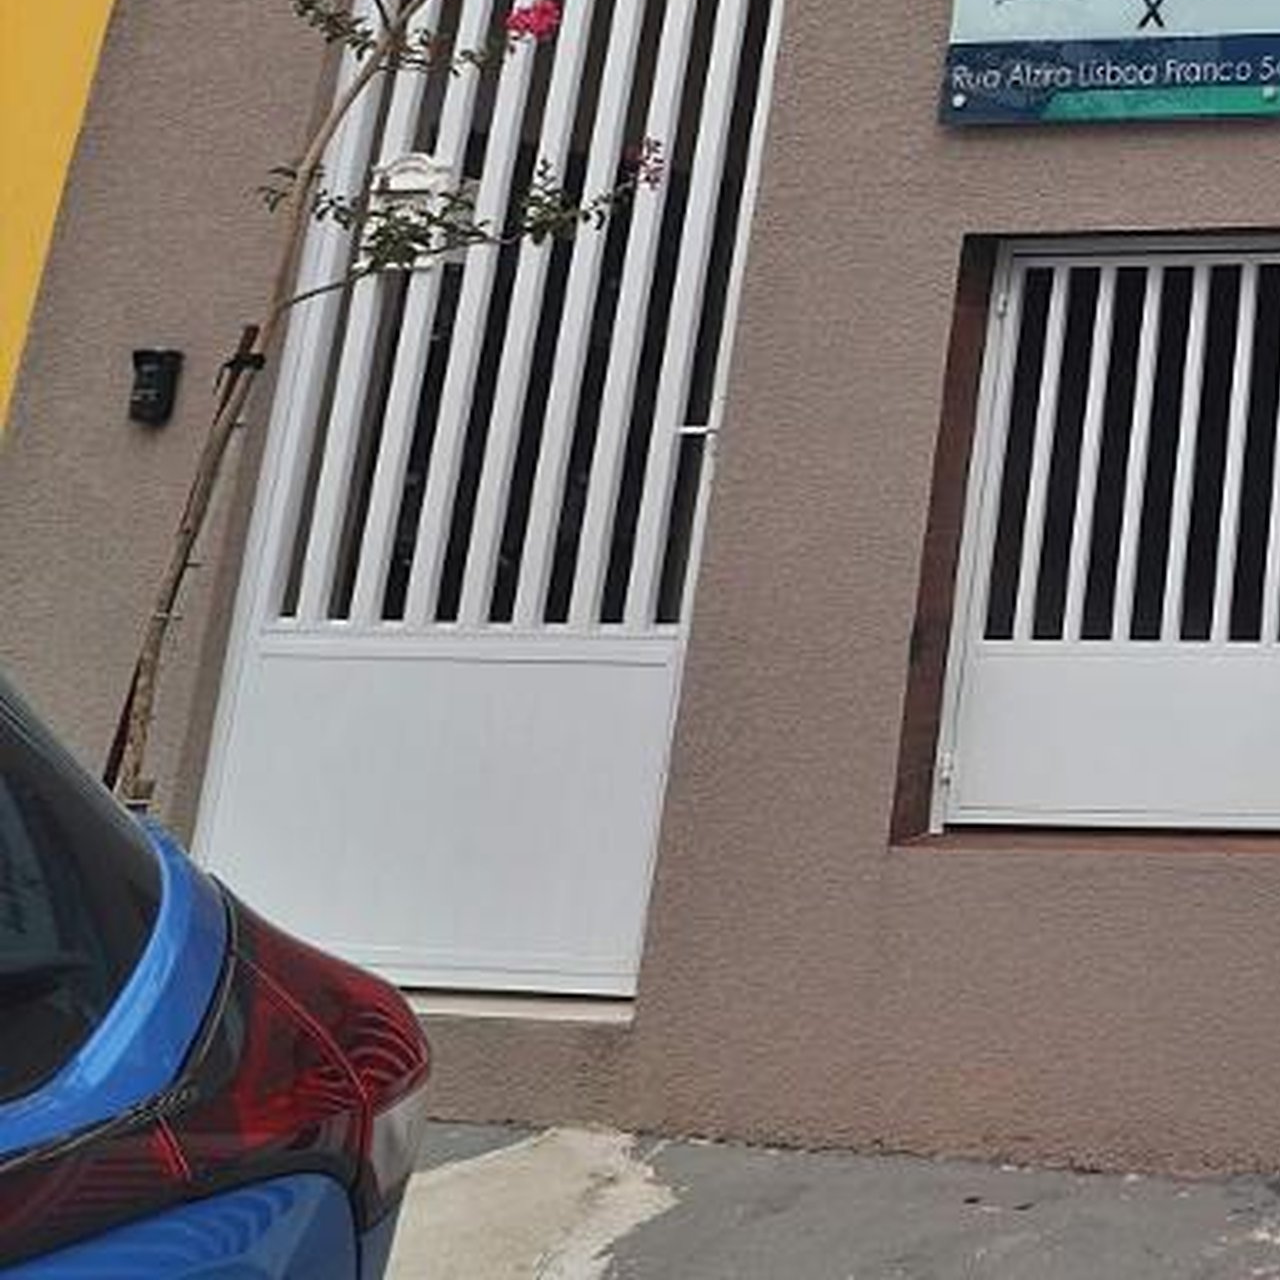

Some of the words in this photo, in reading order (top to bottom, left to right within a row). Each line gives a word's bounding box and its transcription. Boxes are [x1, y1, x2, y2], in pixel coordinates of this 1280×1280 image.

[952, 65, 1001, 90] Rua
[1078, 59, 1159, 87] Lisboa
[1165, 58, 1252, 83] Franco
